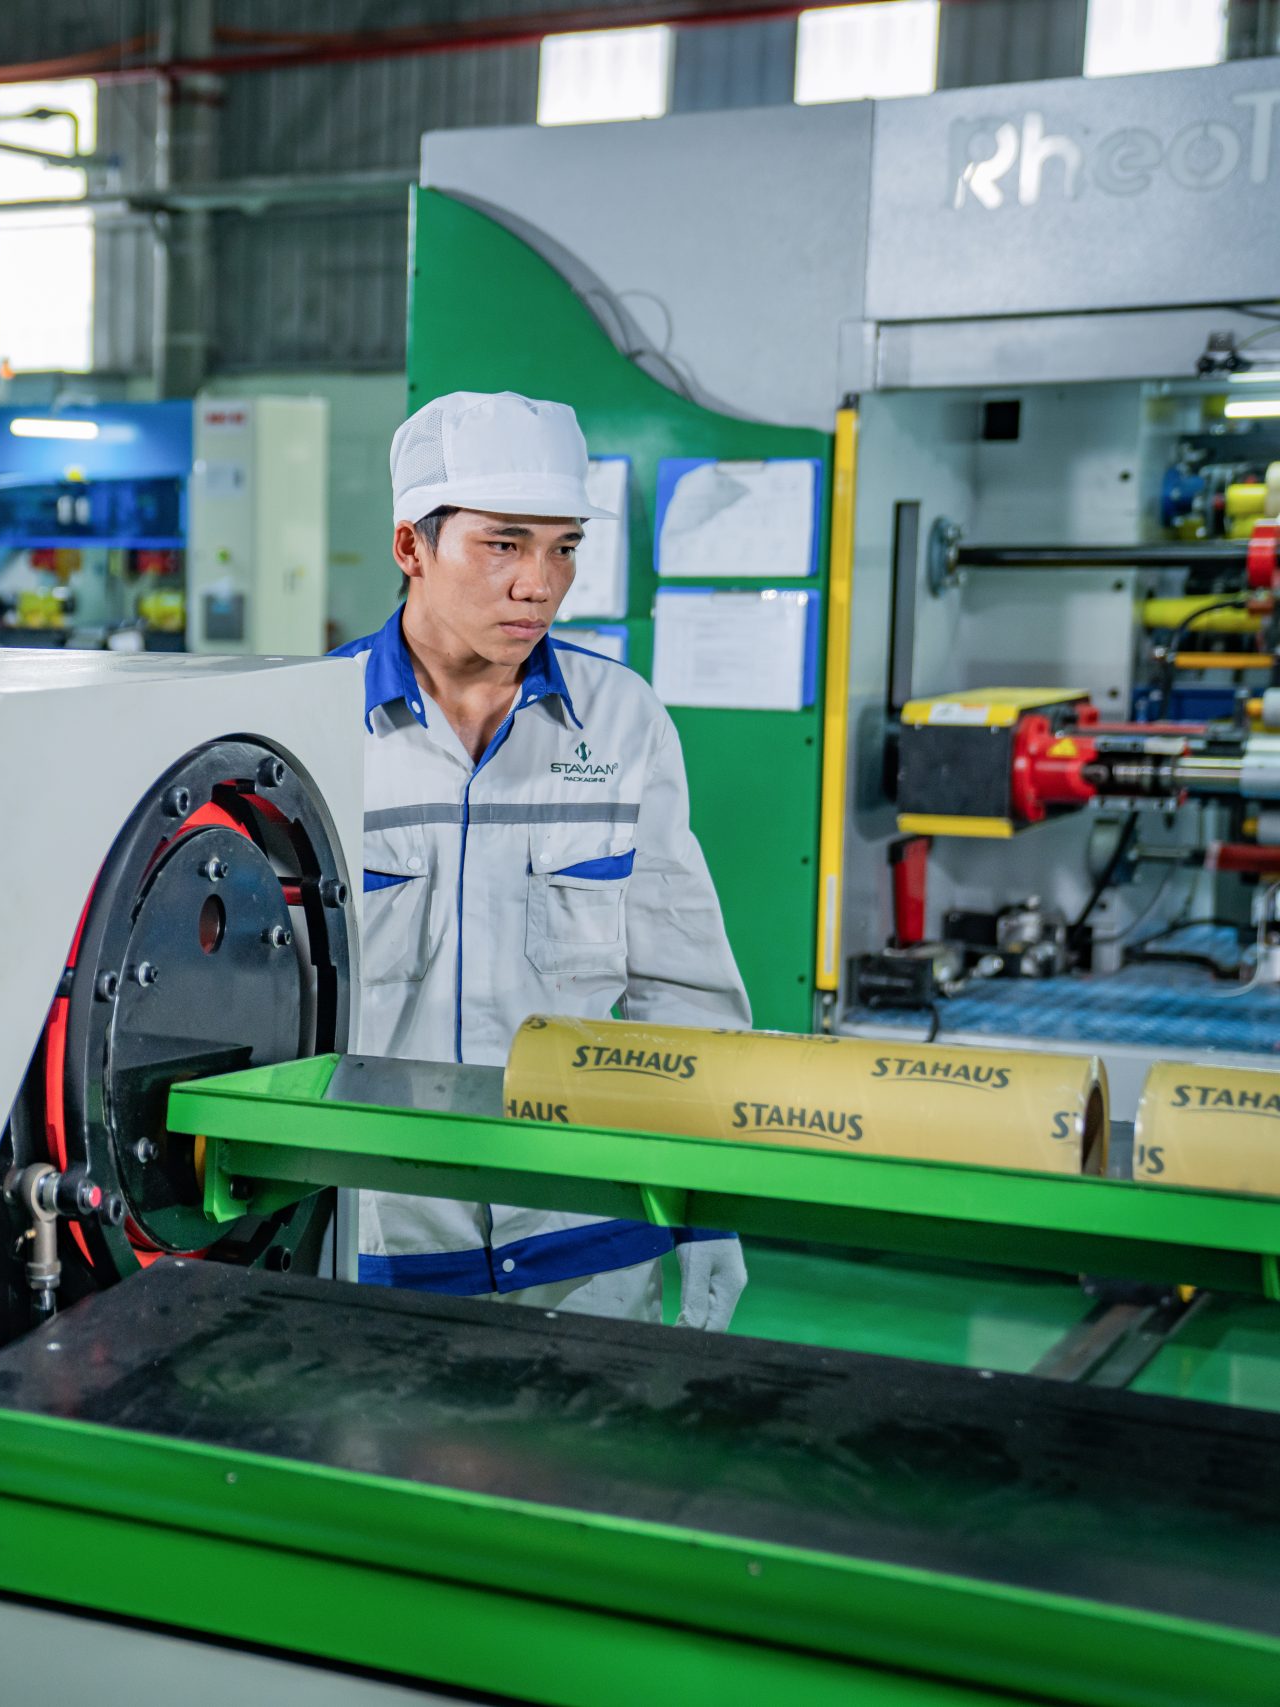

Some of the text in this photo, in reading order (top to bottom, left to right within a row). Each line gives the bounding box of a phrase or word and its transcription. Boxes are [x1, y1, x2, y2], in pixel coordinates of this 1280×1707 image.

[571, 1045, 698, 1079] STAHAUS
[871, 1056, 1012, 1089] STAHAUS
[731, 1101, 863, 1141] STAHAUS
